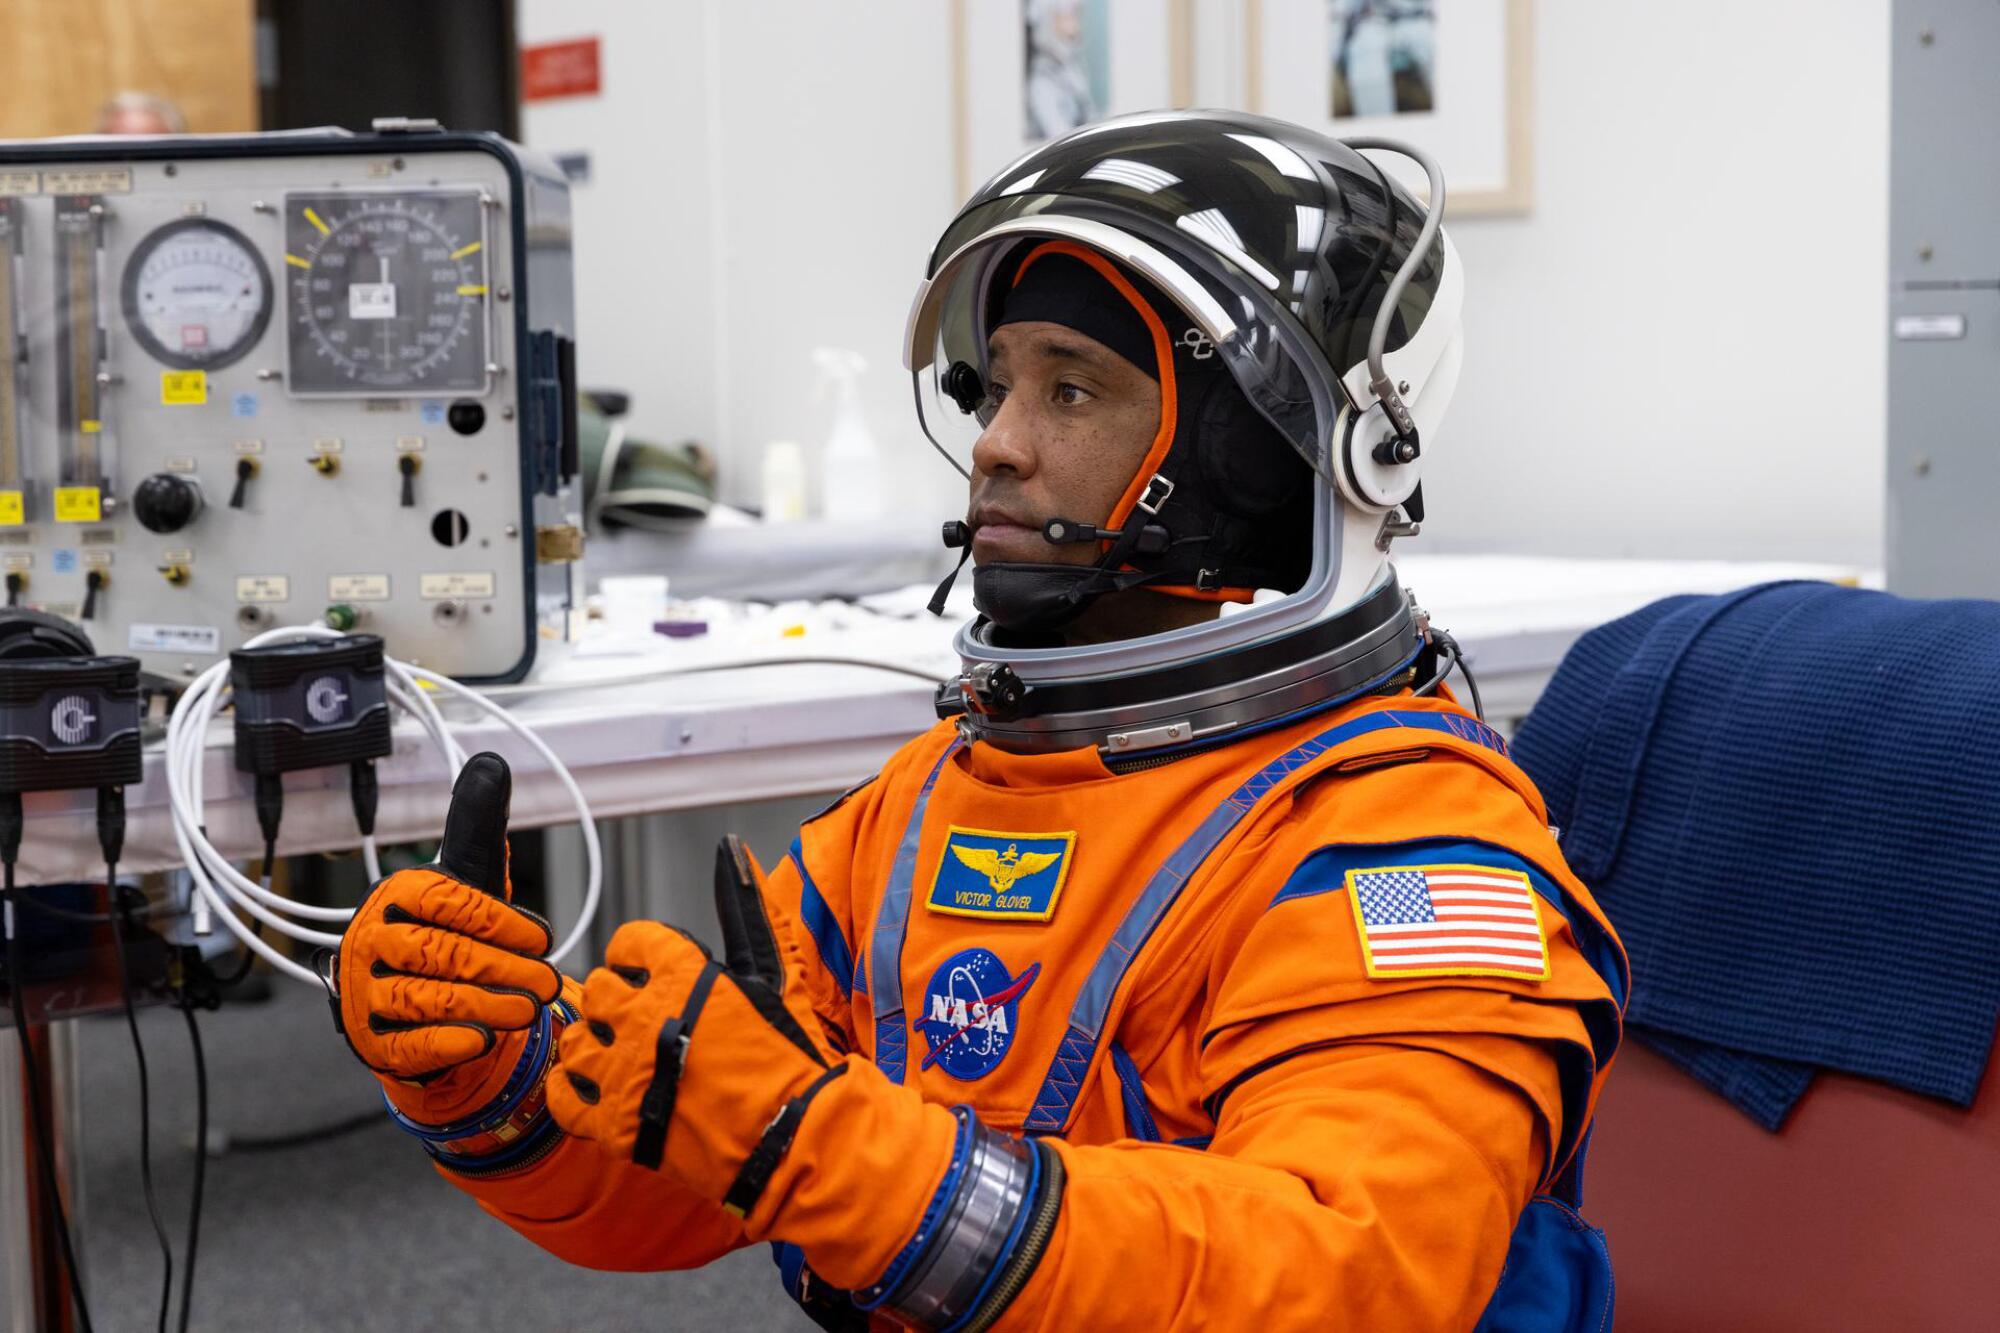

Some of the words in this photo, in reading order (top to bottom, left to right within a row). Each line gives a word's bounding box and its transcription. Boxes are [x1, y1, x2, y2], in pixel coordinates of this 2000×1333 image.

[955, 890, 991, 907] VICTOR
[996, 895, 1032, 910] GLOVER
[929, 994, 1008, 1034] NASA
